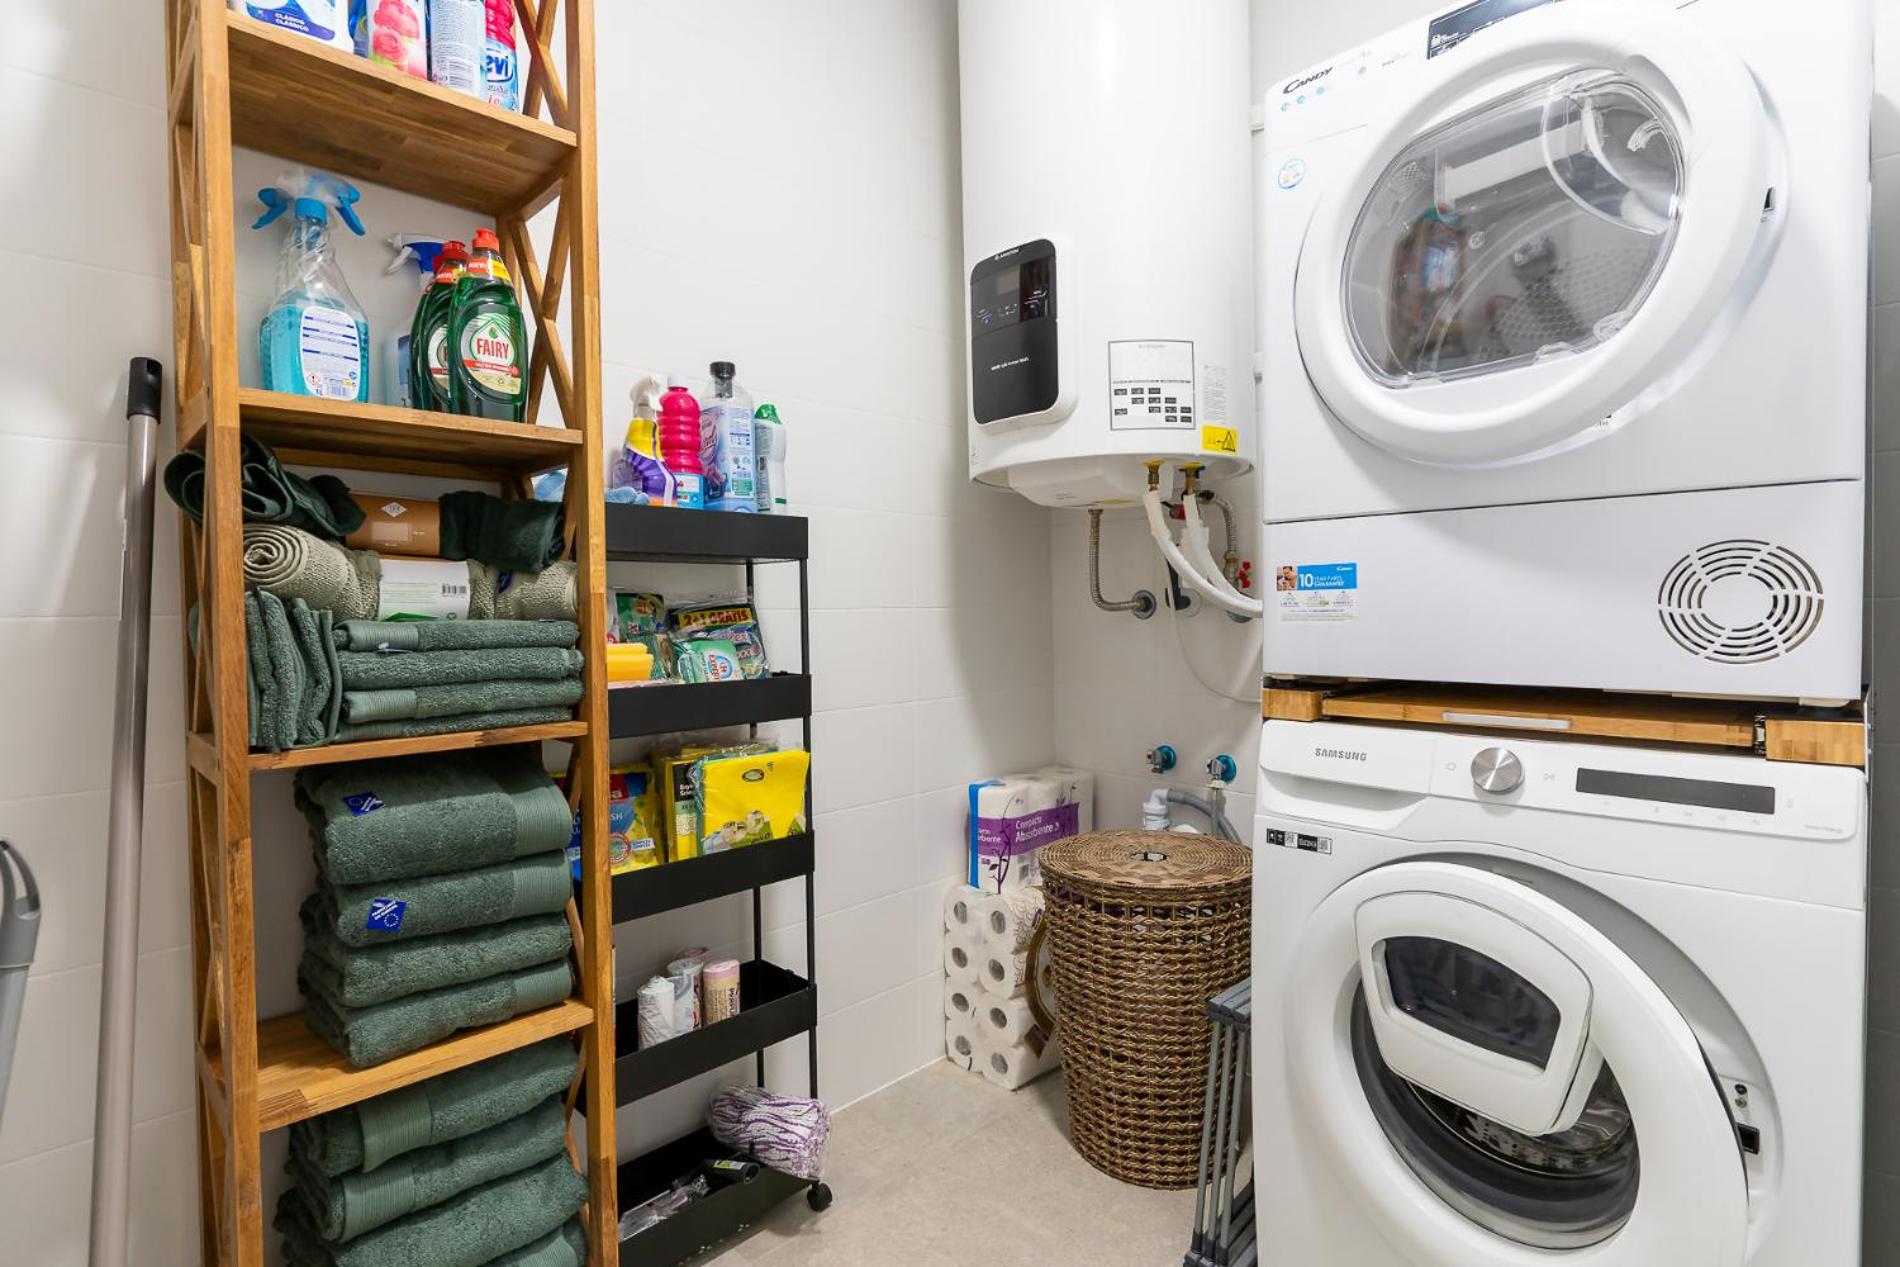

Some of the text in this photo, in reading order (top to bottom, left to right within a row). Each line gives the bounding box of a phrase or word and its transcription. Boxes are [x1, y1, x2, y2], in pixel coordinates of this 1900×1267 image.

[476, 338, 509, 359] FAIRY
[1300, 573, 1313, 588] 10
[1315, 747, 1367, 761] SAMSUNG
